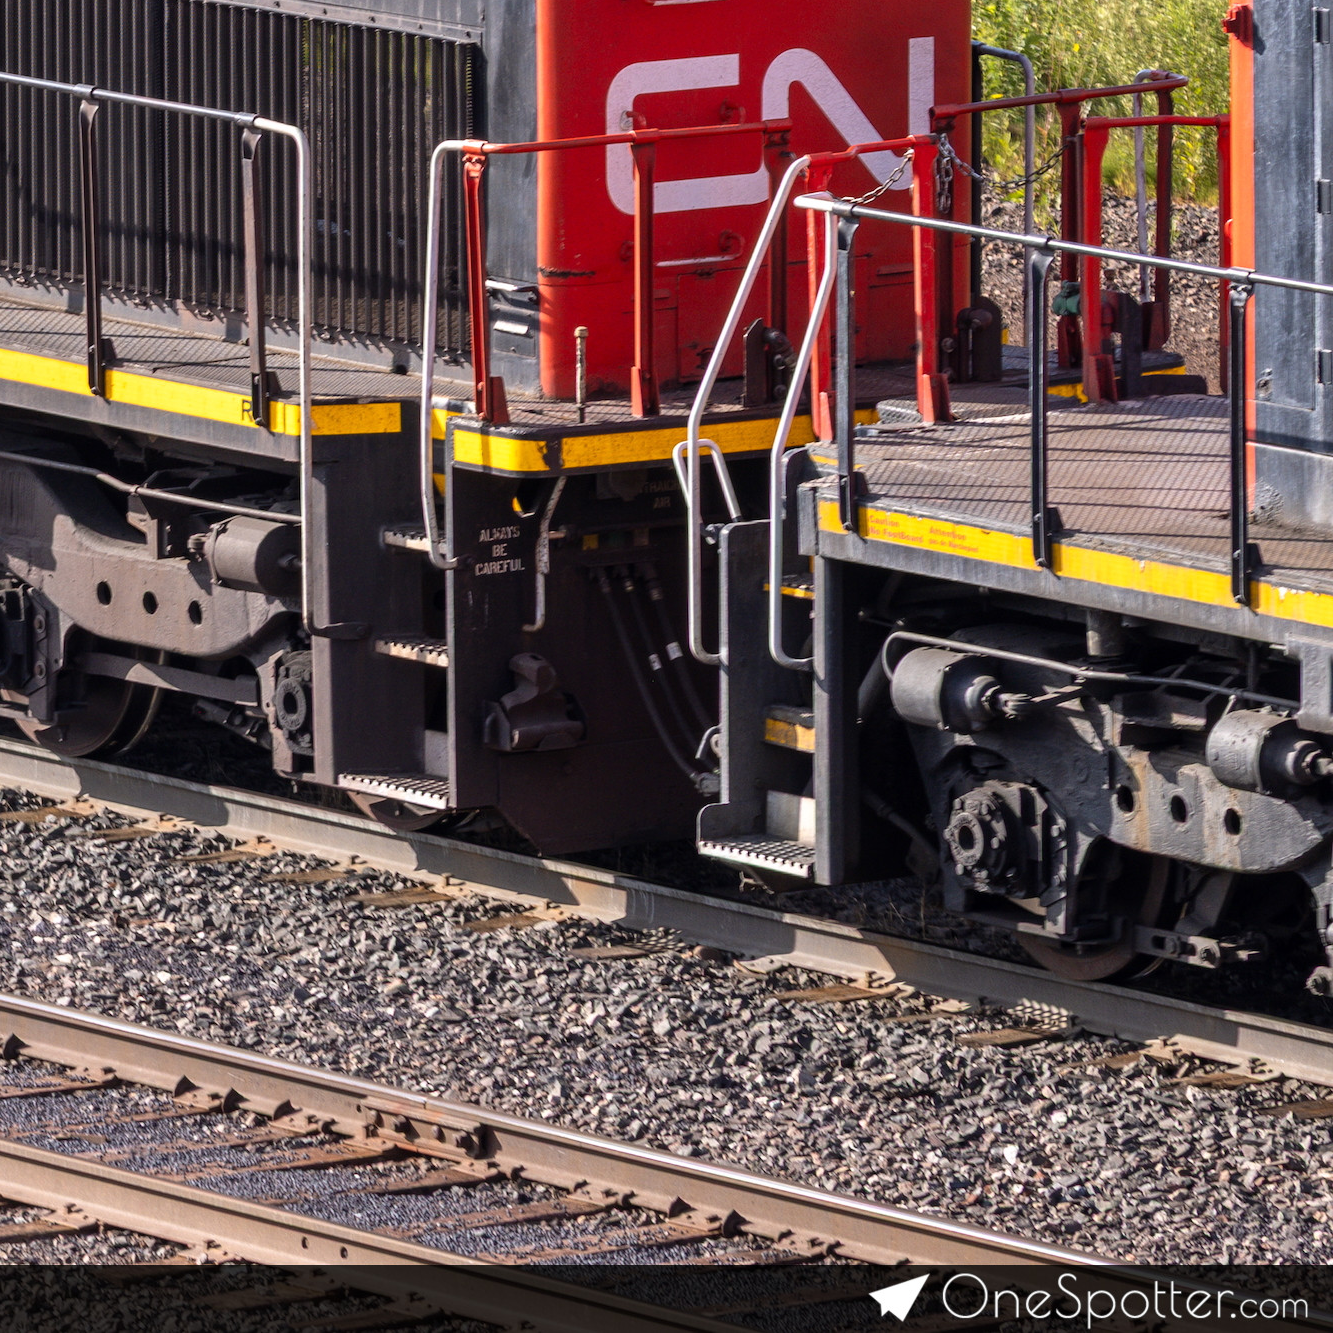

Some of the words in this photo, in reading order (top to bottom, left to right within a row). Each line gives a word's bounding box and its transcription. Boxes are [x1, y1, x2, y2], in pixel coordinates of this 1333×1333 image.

[605, 36, 935, 216] CN
[241, 399, 254, 423] R
[478, 526, 520, 542] ALWAYS
[492, 543, 508, 557] BE
[474, 558, 525, 576] CAREFUL
